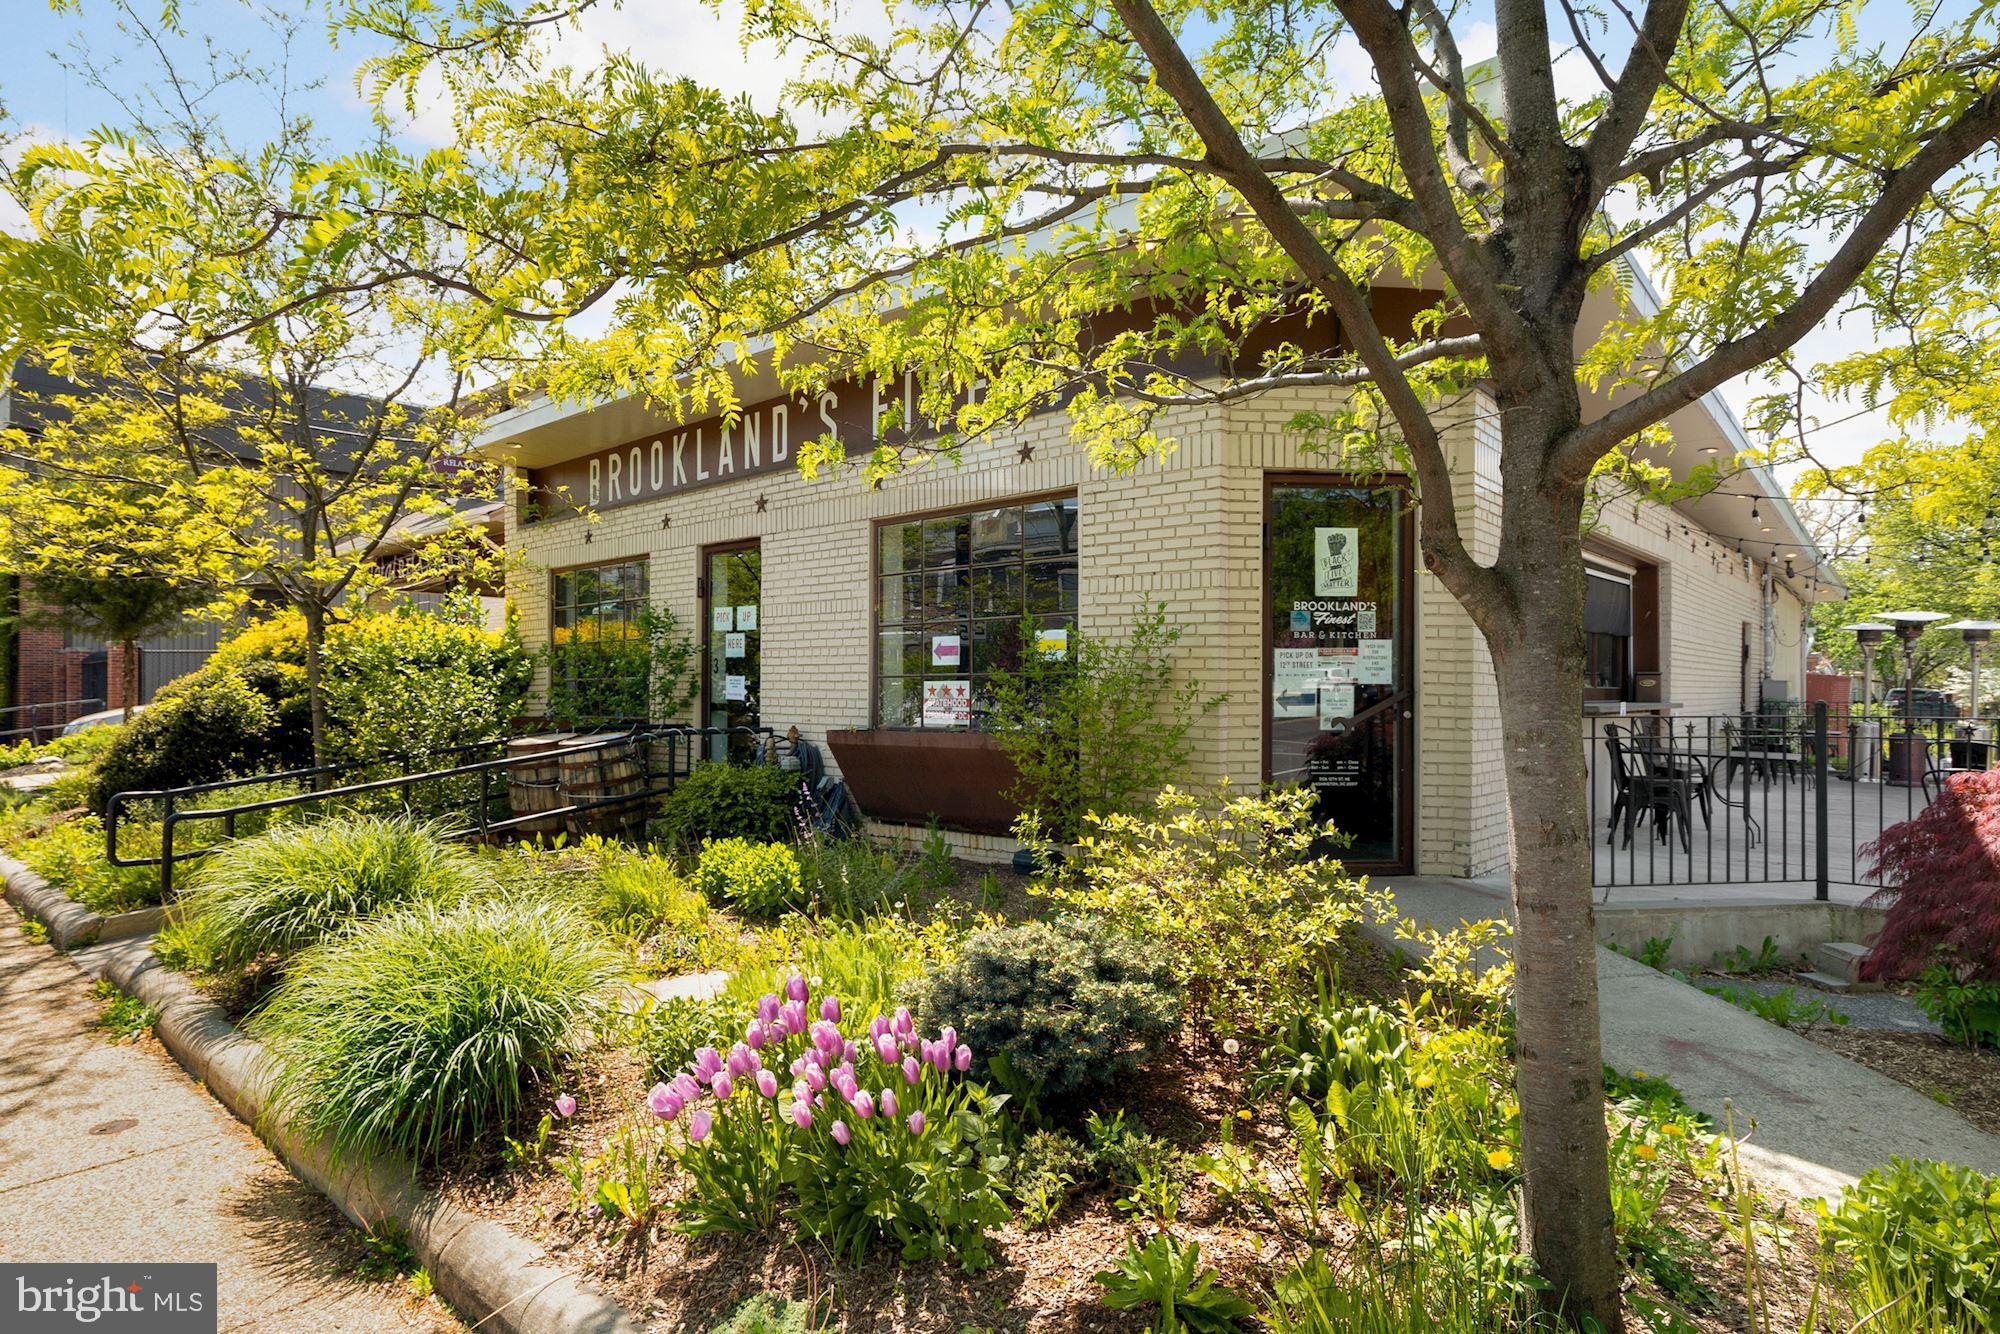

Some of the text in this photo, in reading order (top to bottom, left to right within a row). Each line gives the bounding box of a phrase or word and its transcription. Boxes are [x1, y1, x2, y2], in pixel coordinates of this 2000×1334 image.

[589, 391, 838, 507] BROOKLAND'S
[1323, 553, 1347, 568] BLACK
[1326, 568, 1347, 580] LIVES
[1323, 580, 1350, 588] MATTER
[1293, 601, 1377, 611] BROOKLAND'S
[716, 612, 730, 622] PICK
[742, 611, 752, 622] UP
[1313, 611, 1356, 625] Finest
[1293, 630, 1377, 640] BAR & KITCHEN
[728, 639, 743, 649] HERE
